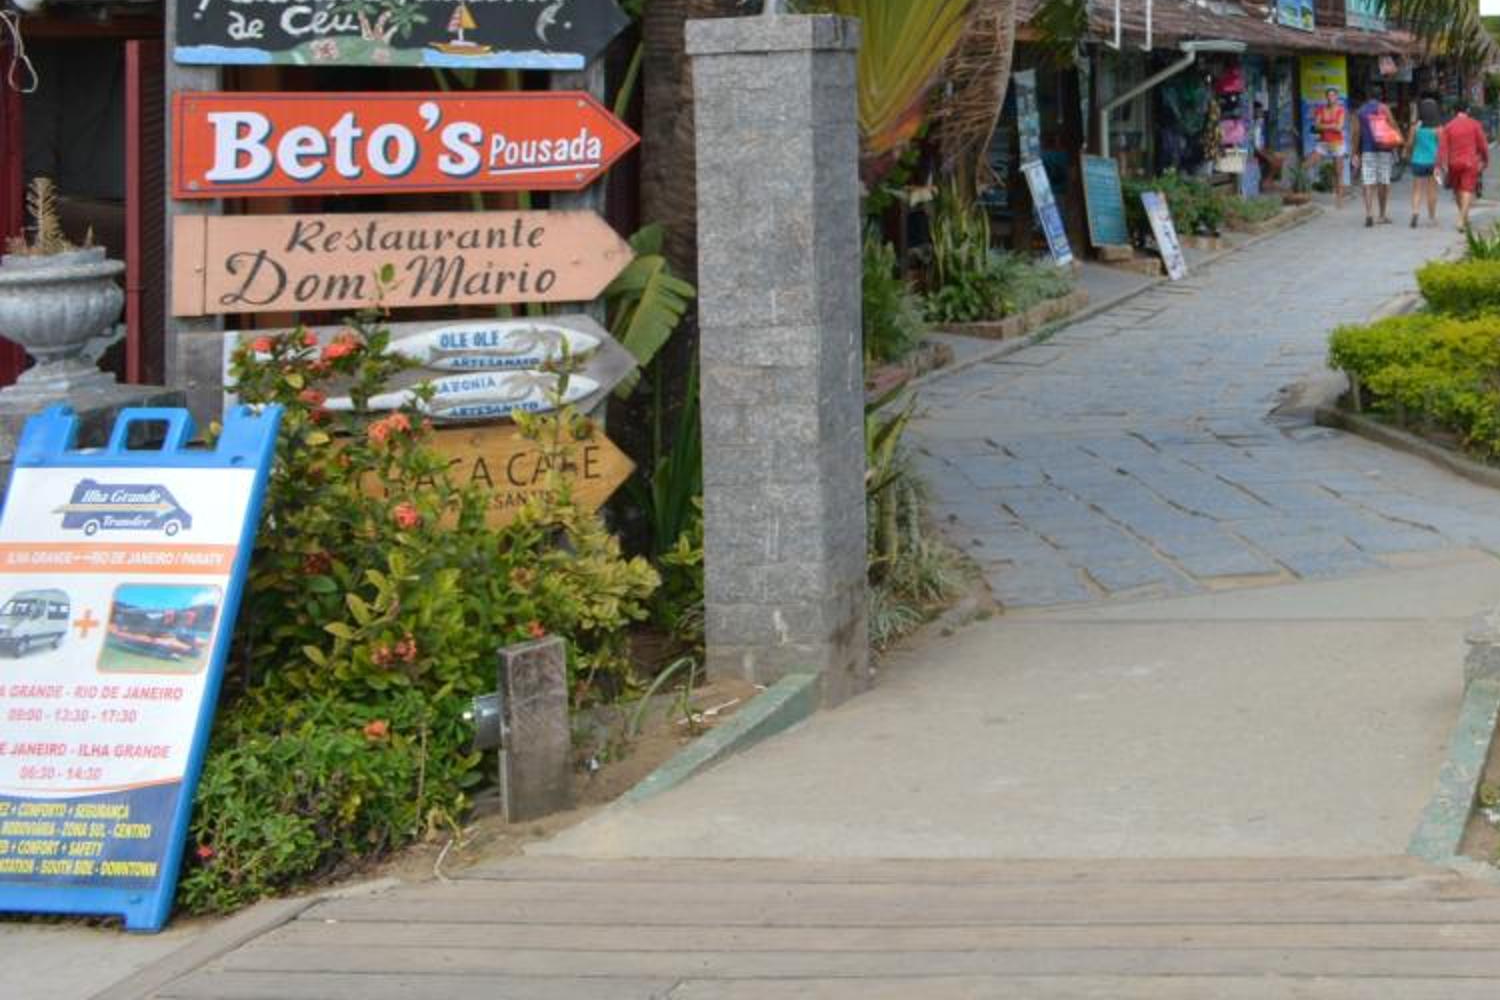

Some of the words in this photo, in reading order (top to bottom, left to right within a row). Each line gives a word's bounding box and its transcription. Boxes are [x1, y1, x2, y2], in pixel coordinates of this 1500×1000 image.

[279, 2, 360, 35] Céu
[204, 101, 483, 183] Beto's
[488, 128, 601, 166] Pousada
[285, 217, 546, 253] Restaurante
[219, 249, 365, 306] Dom
[101, 686, 120, 699] DE
[122, 687, 184, 700] JANEIRO
[10, 743, 67, 756] JANEIRO
[79, 744, 110, 757] ILHA
[112, 745, 171, 758] GRANDE
